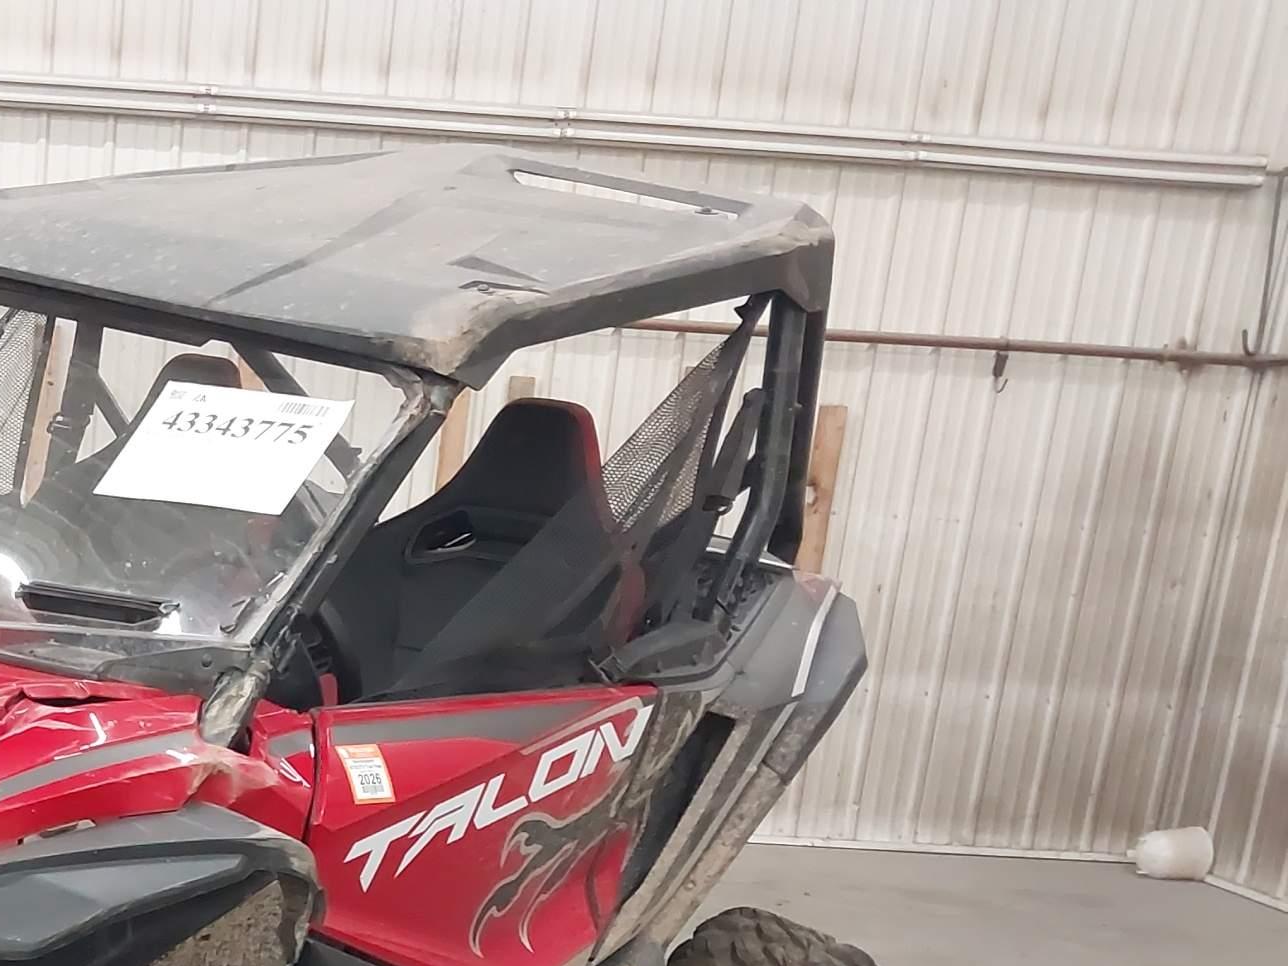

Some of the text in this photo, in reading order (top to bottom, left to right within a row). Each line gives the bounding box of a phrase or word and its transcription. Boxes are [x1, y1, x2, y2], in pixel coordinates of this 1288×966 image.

[162, 410, 314, 444] 43343775
[358, 772, 382, 786] 2026
[343, 704, 654, 893] TALON
